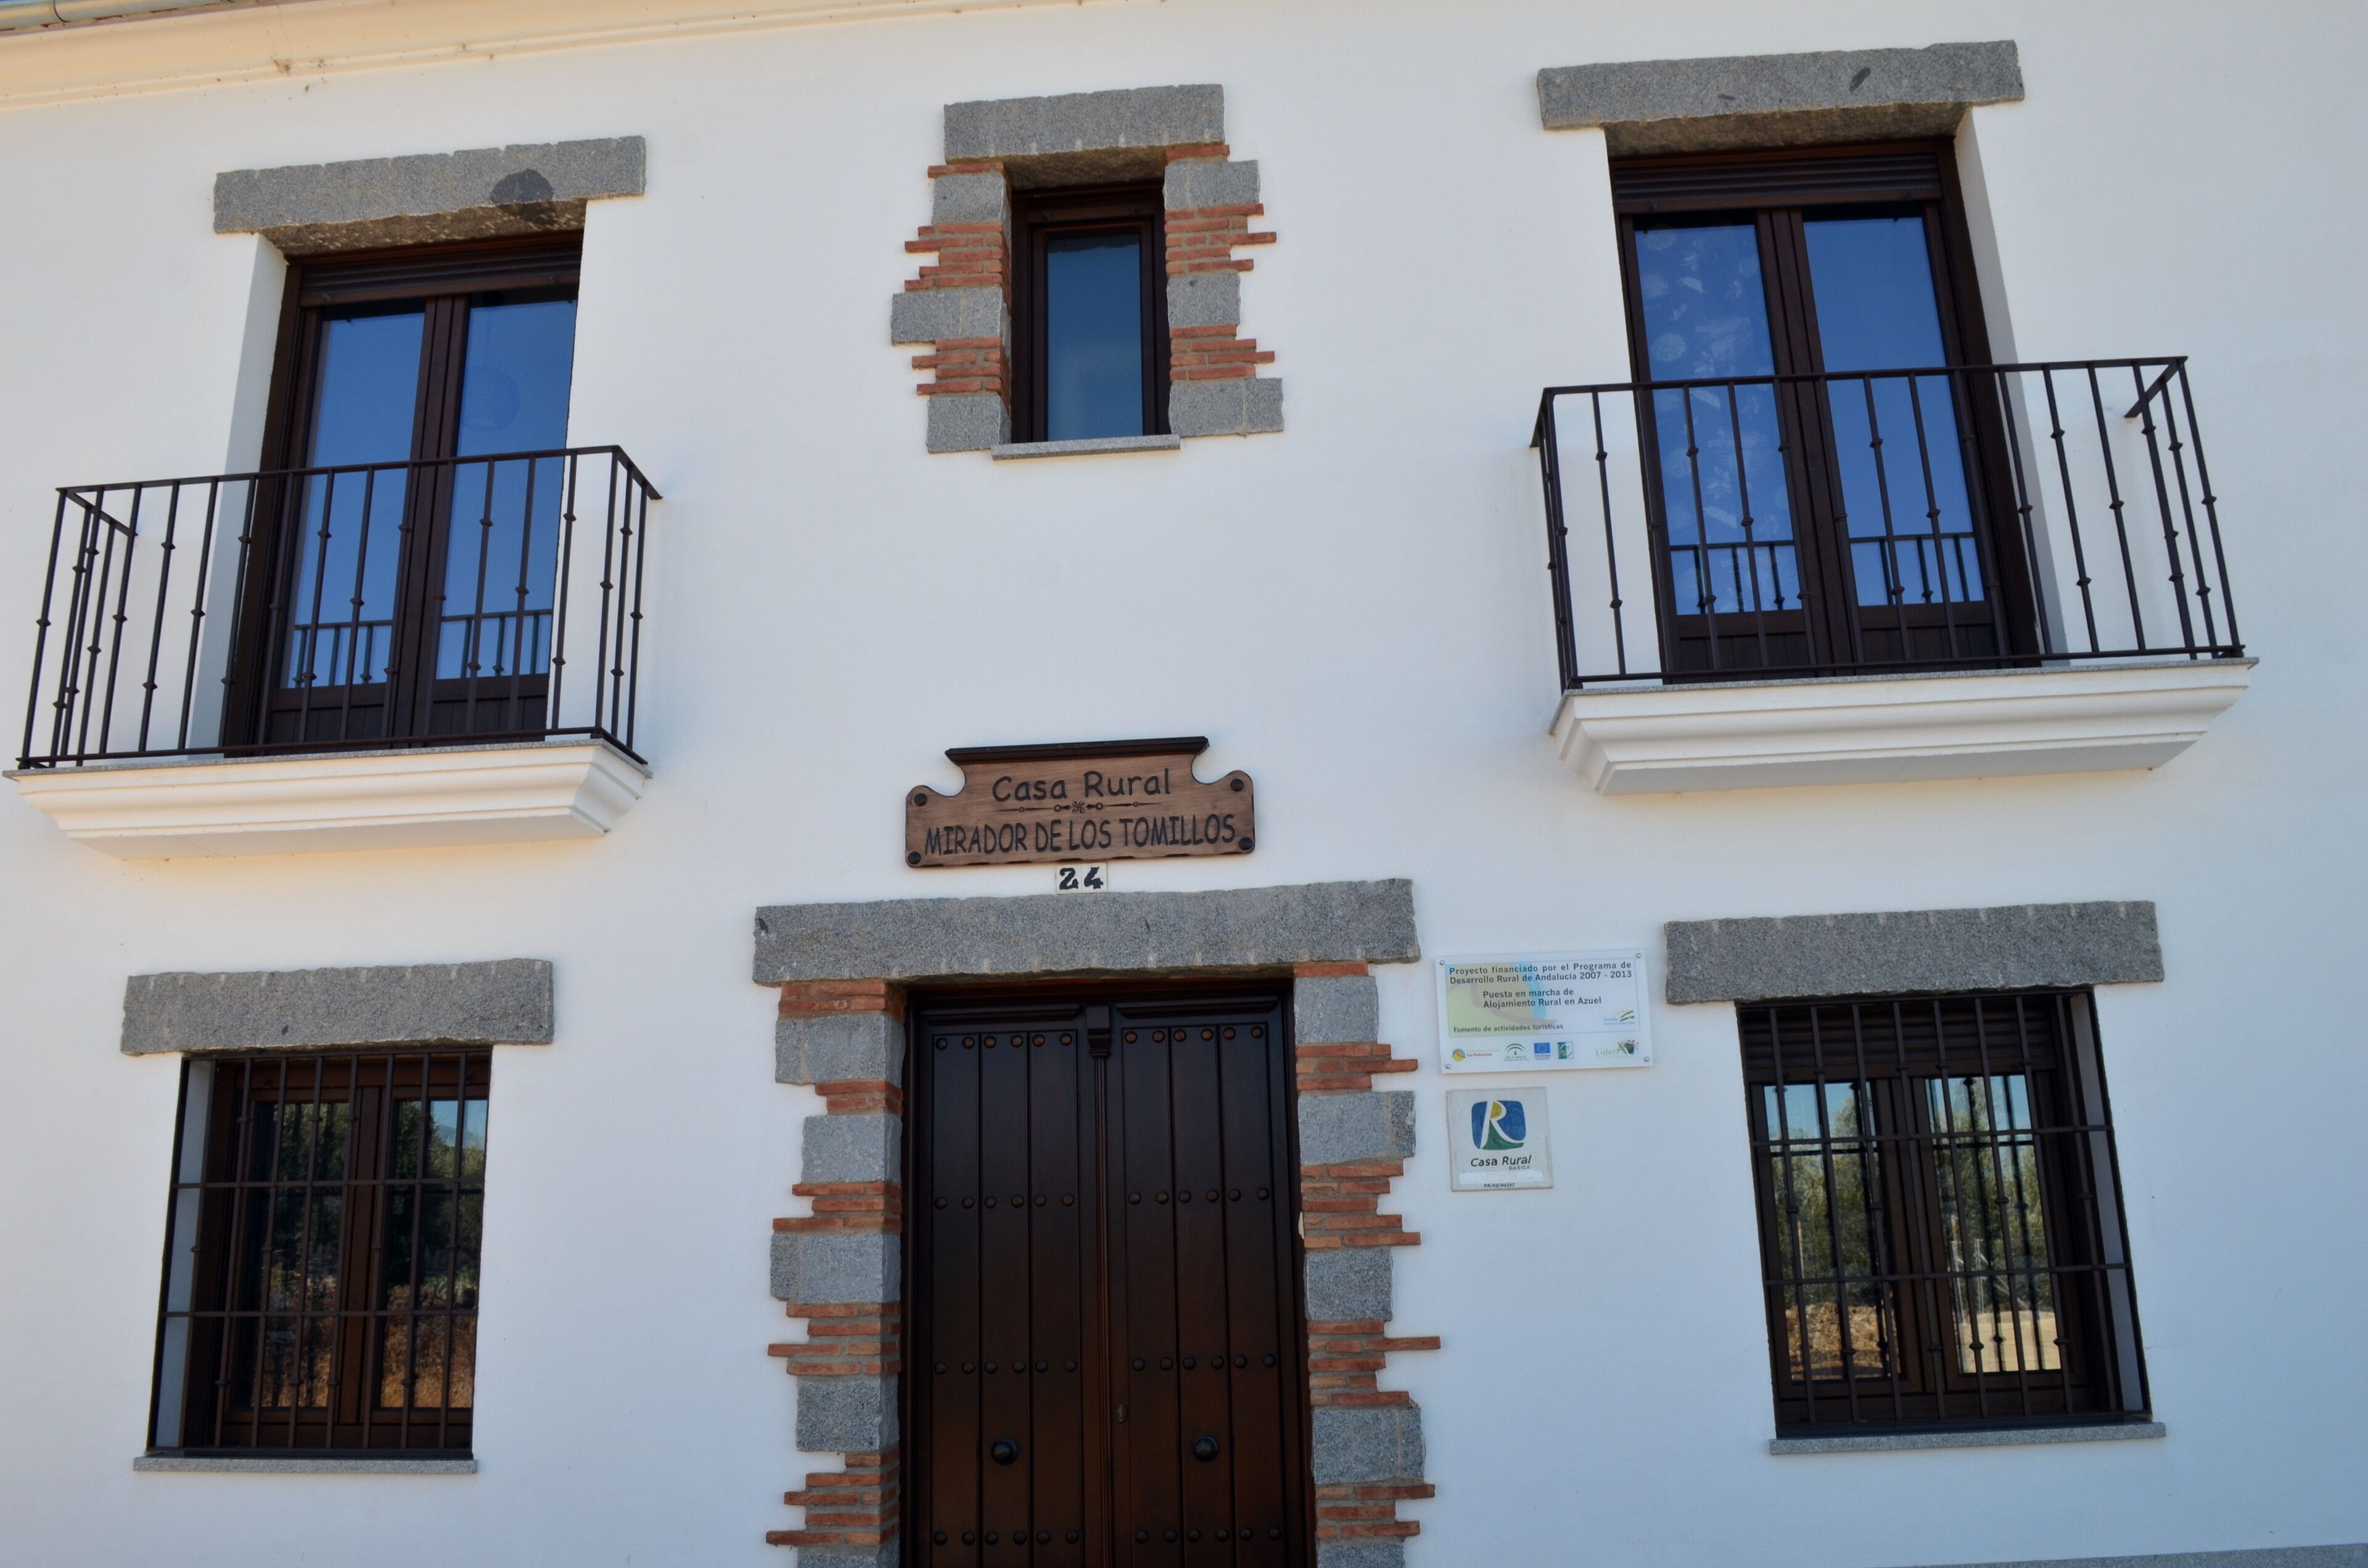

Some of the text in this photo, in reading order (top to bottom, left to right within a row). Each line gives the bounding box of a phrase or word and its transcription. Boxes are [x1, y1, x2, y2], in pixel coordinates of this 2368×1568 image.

[992, 768, 1171, 802] Casa Rural
[925, 813, 1235, 855] MIRADOR DE LOS TOMILLOS
[1059, 866, 1104, 890] 24
[1450, 967, 1488, 976] Proyecto
[1492, 964, 1538, 974] financiado
[1573, 963, 1616, 971] Programa
[1450, 976, 1494, 984] Desarrollo
[1536, 972, 1577, 980] Andalucía
[1580, 972, 1601, 980] 2007
[1529, 989, 1560, 997] marcha
[1483, 999, 1536, 1009] Alojamiento
[1577, 996, 1601, 1004] Azuel
[1471, 1155, 1532, 1167] Casa Rural
